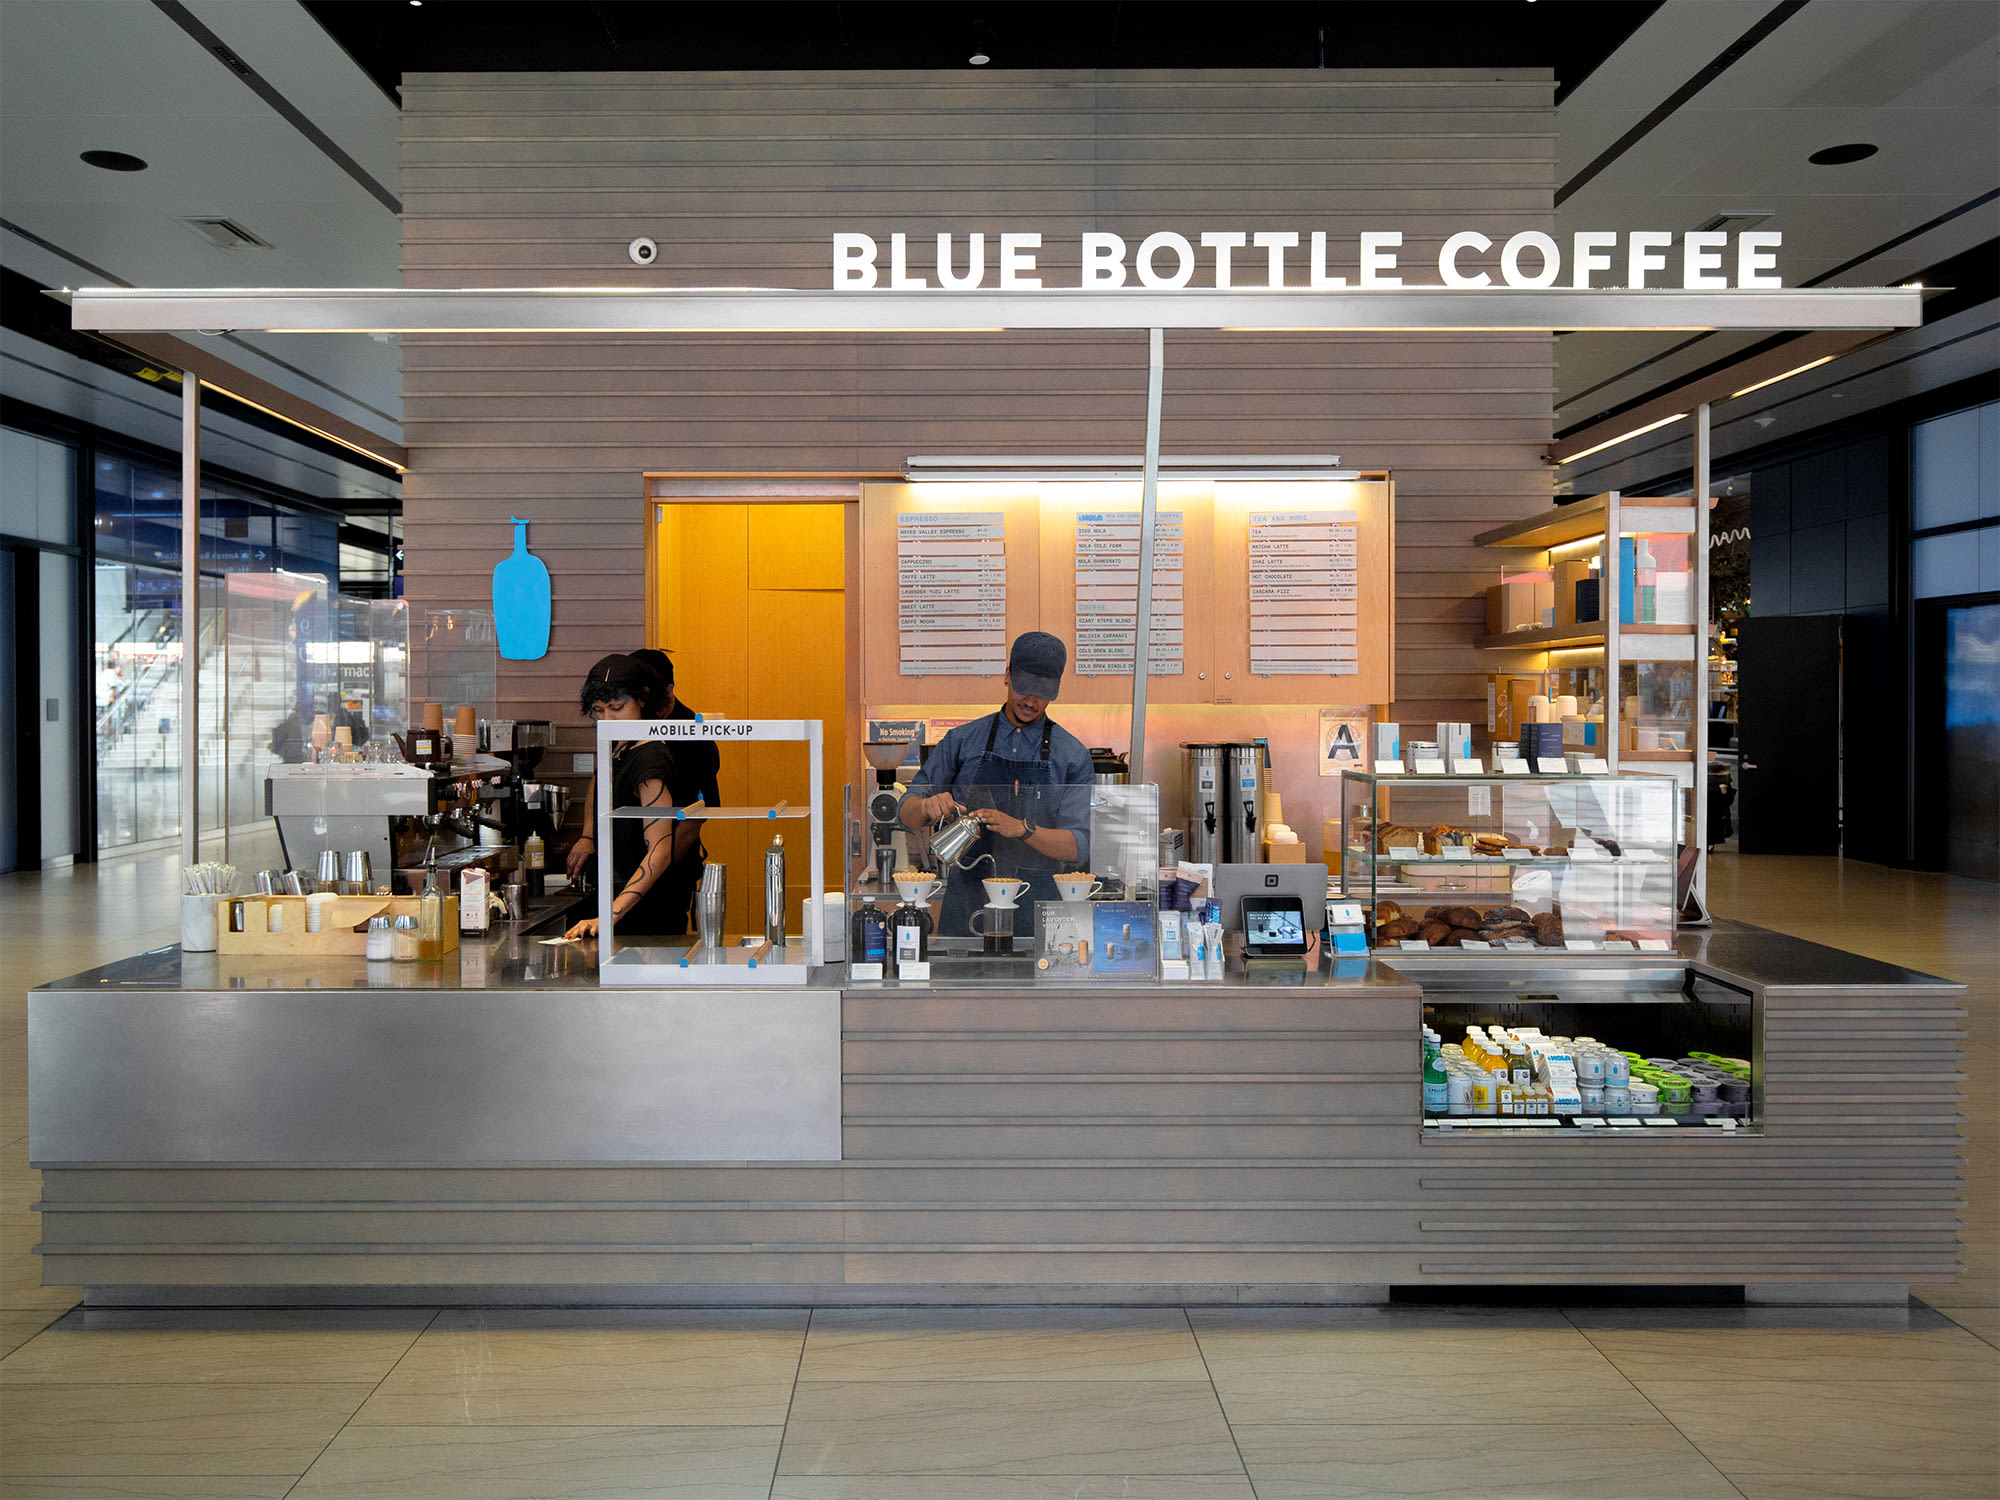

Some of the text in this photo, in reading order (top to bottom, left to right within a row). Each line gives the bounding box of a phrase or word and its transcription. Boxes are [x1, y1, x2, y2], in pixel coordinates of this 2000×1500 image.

[833, 230, 1782, 290] BLUE BOTTLE COFFEE
[648, 725, 753, 736] MOBILE PICK-UP
[879, 727, 915, 737] No Smoking
[1328, 724, 1359, 759] A
